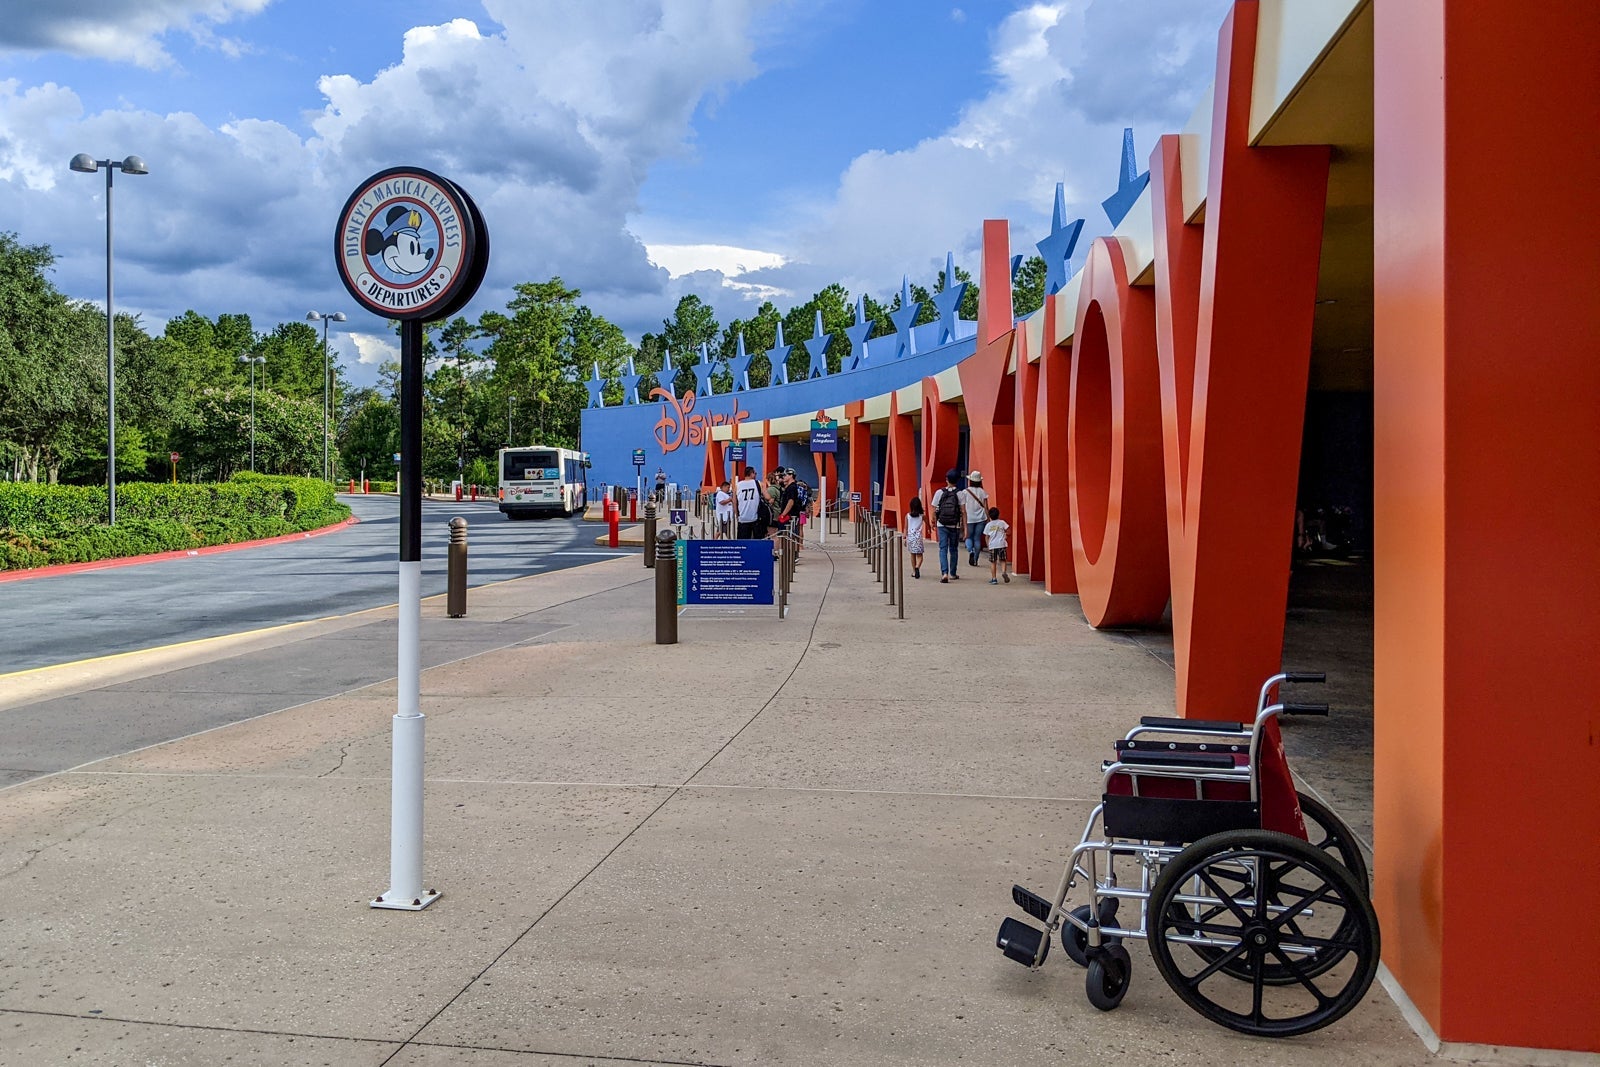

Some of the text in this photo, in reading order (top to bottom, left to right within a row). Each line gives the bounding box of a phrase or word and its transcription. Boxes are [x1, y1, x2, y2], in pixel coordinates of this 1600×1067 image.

[346, 180, 460, 257] DISNEY'S MAGICAL EXPRESS
[367, 278, 441, 307] DEPARTURES
[742, 488, 755, 501] 77
